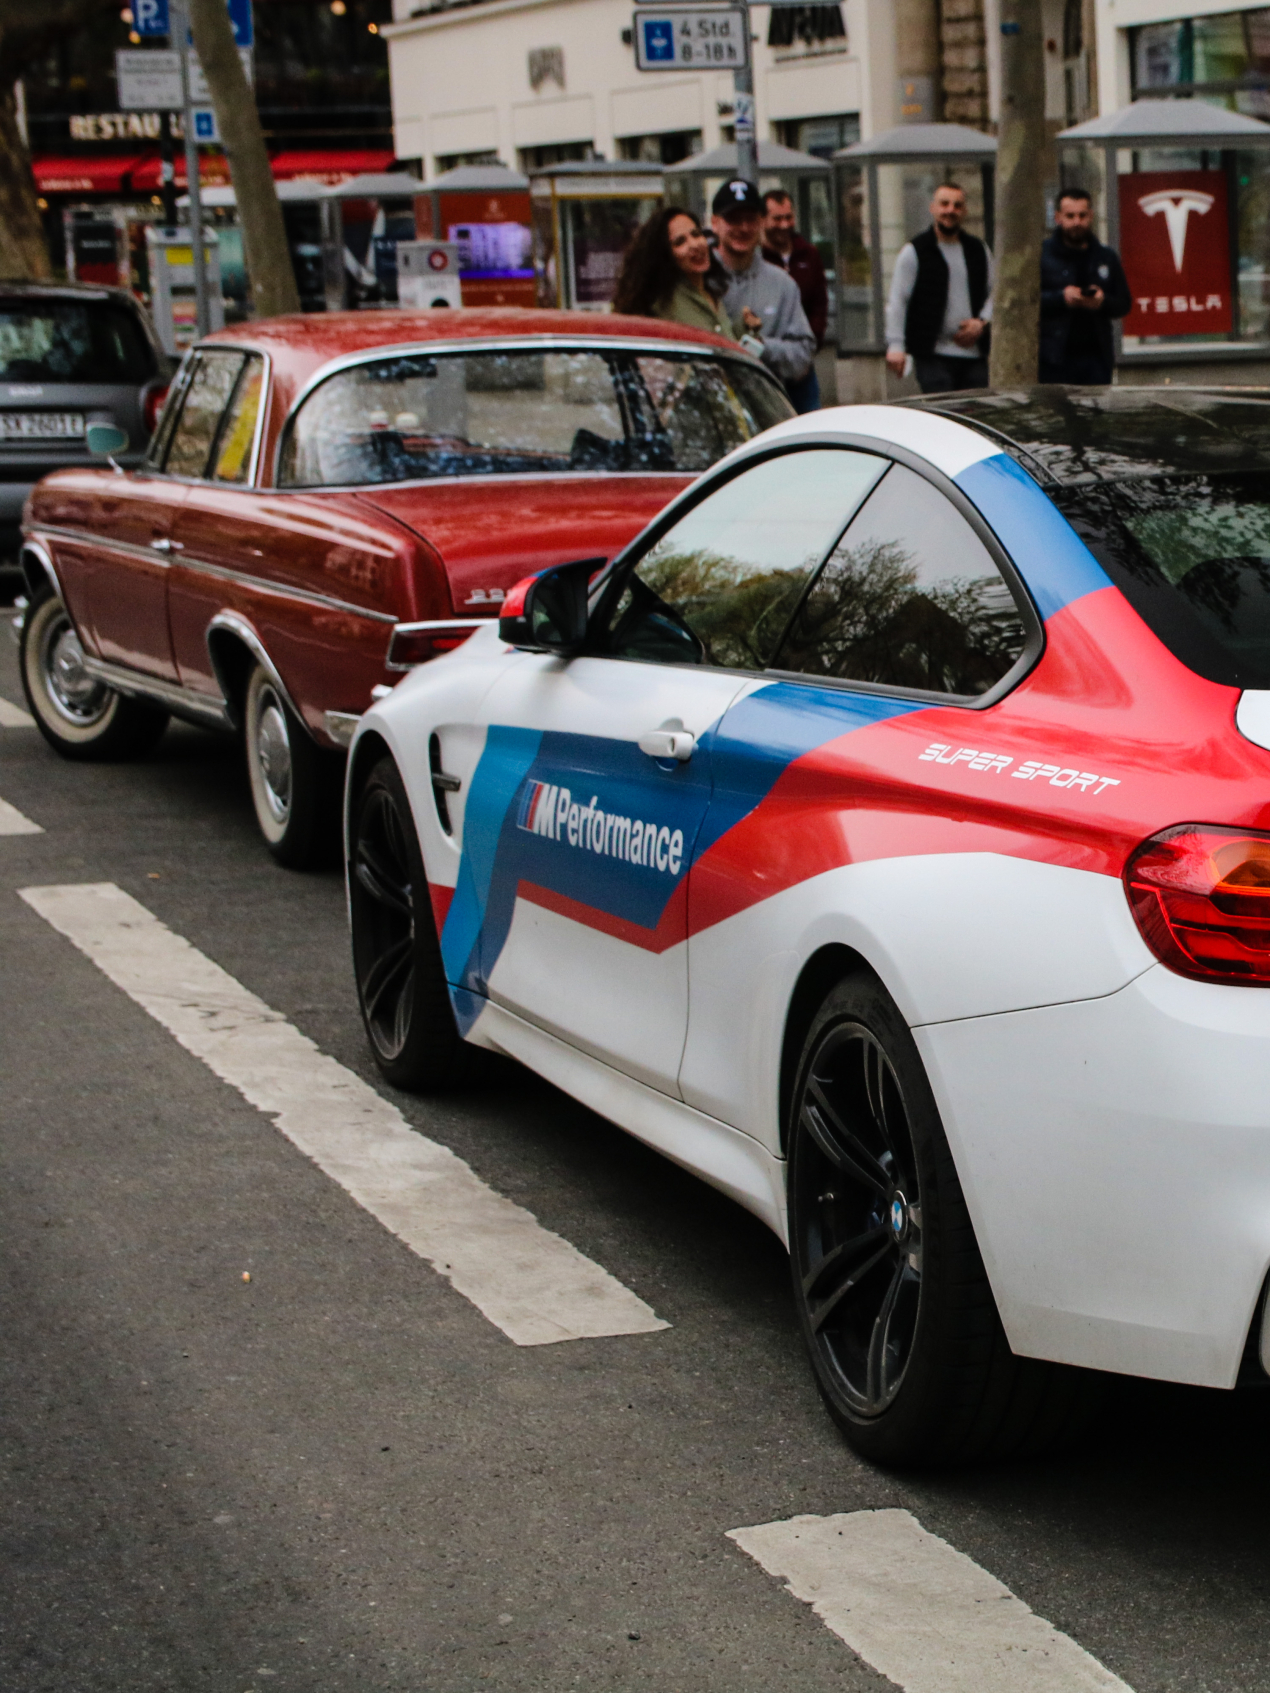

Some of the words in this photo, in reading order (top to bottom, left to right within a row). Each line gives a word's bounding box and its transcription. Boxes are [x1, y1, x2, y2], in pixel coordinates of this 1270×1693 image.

[680, 19, 692, 38] 4
[69, 112, 186, 141] RESTAU
[1136, 294, 1222, 314] TESLA
[918, 743, 1014, 774] SUPER
[1011, 761, 1121, 795] SPORT
